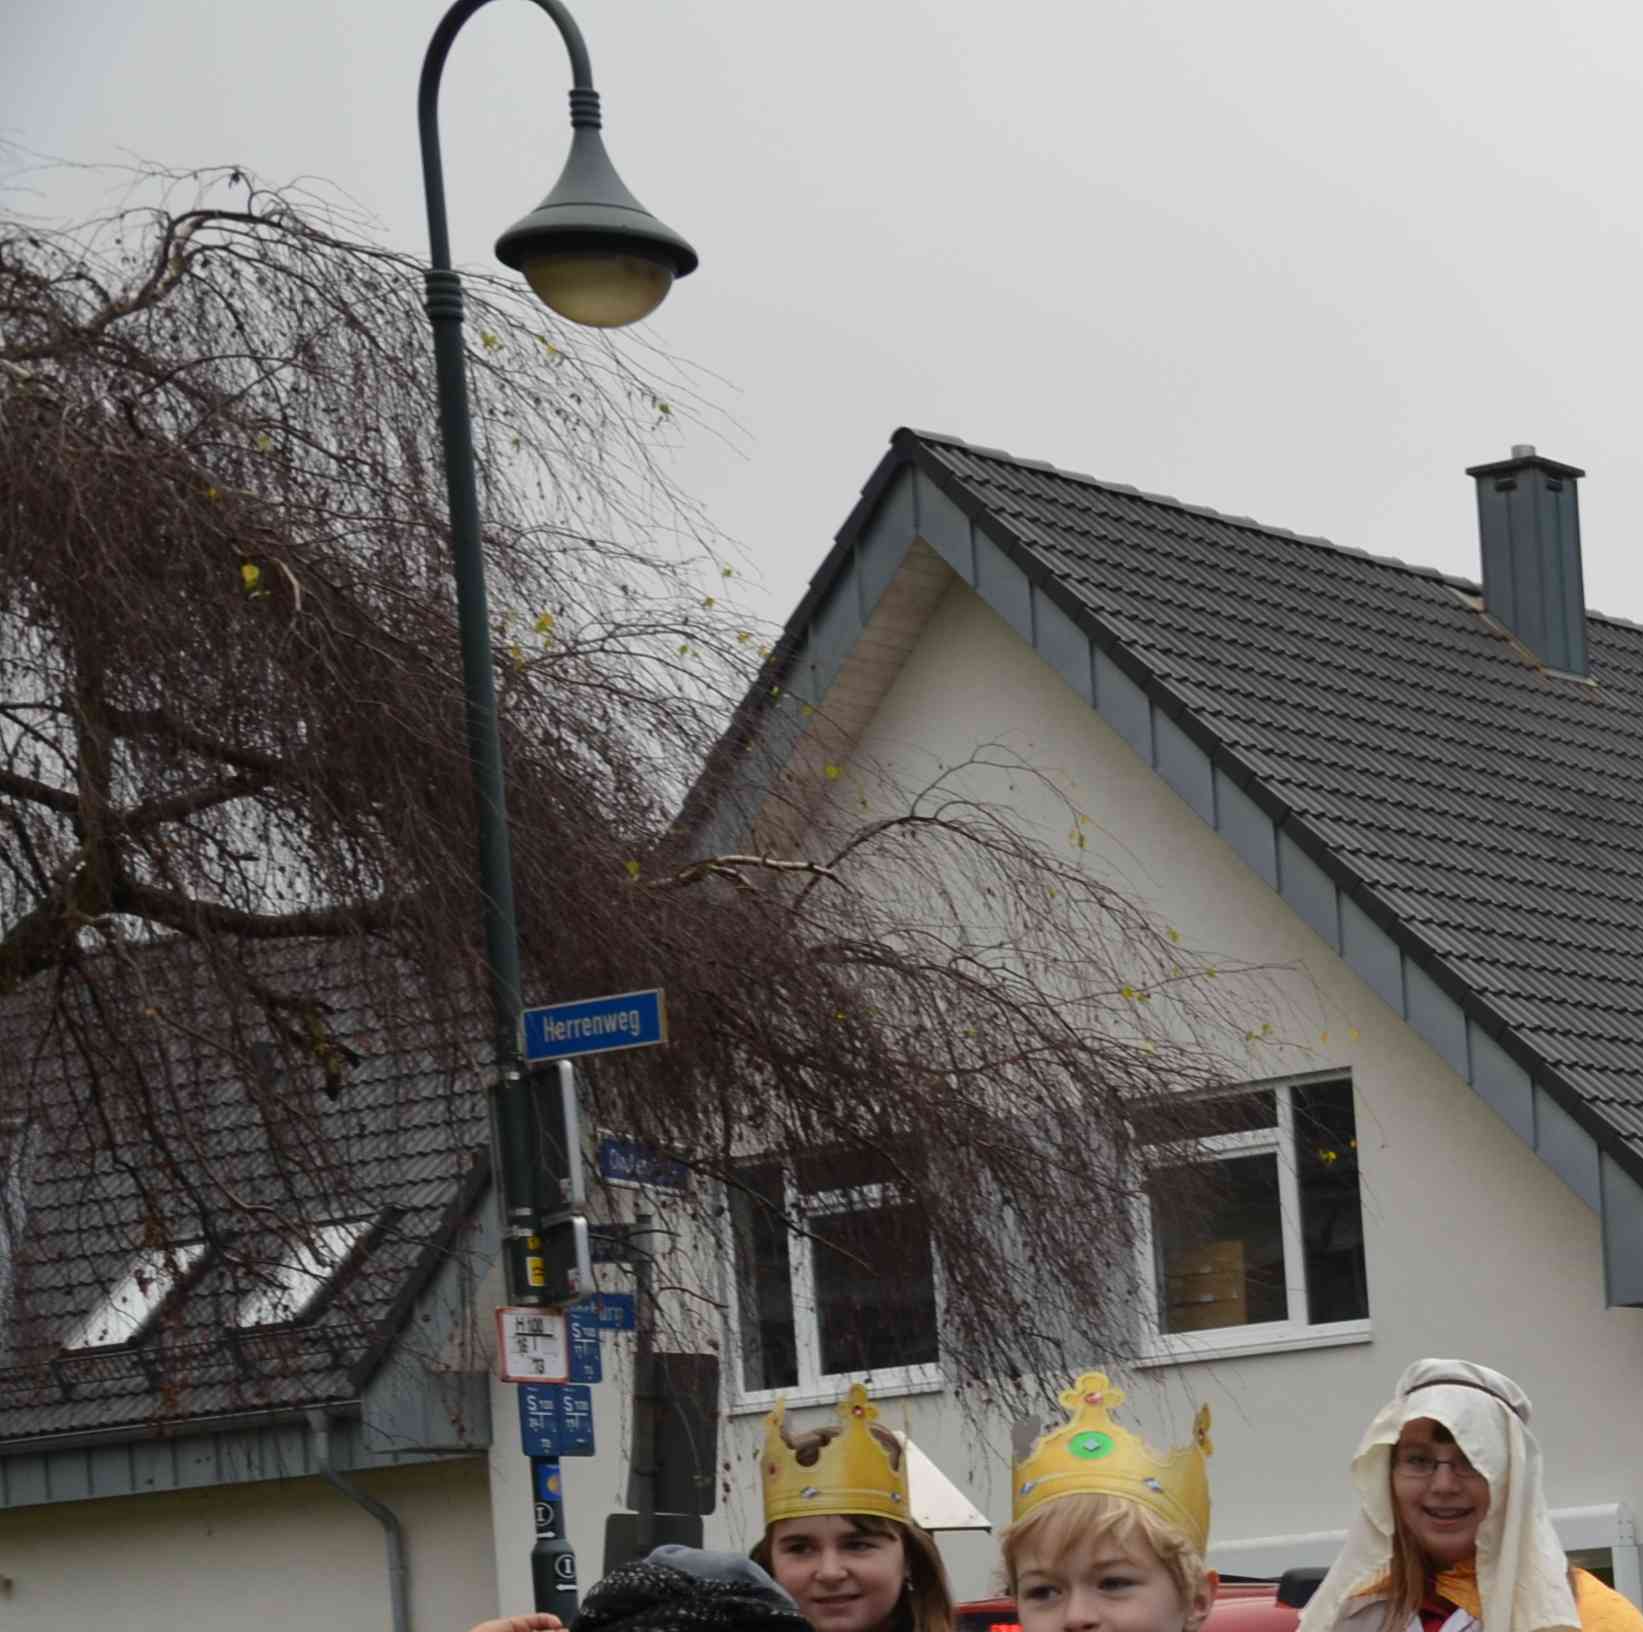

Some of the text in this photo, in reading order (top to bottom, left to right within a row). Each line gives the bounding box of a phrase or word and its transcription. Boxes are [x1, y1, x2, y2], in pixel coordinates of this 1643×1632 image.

[543, 1009, 640, 1043] Herrenweg
[515, 1317, 524, 1332] H
[571, 1322, 580, 1338] S
[527, 1395, 537, 1411] S
[563, 1396, 573, 1412] S
